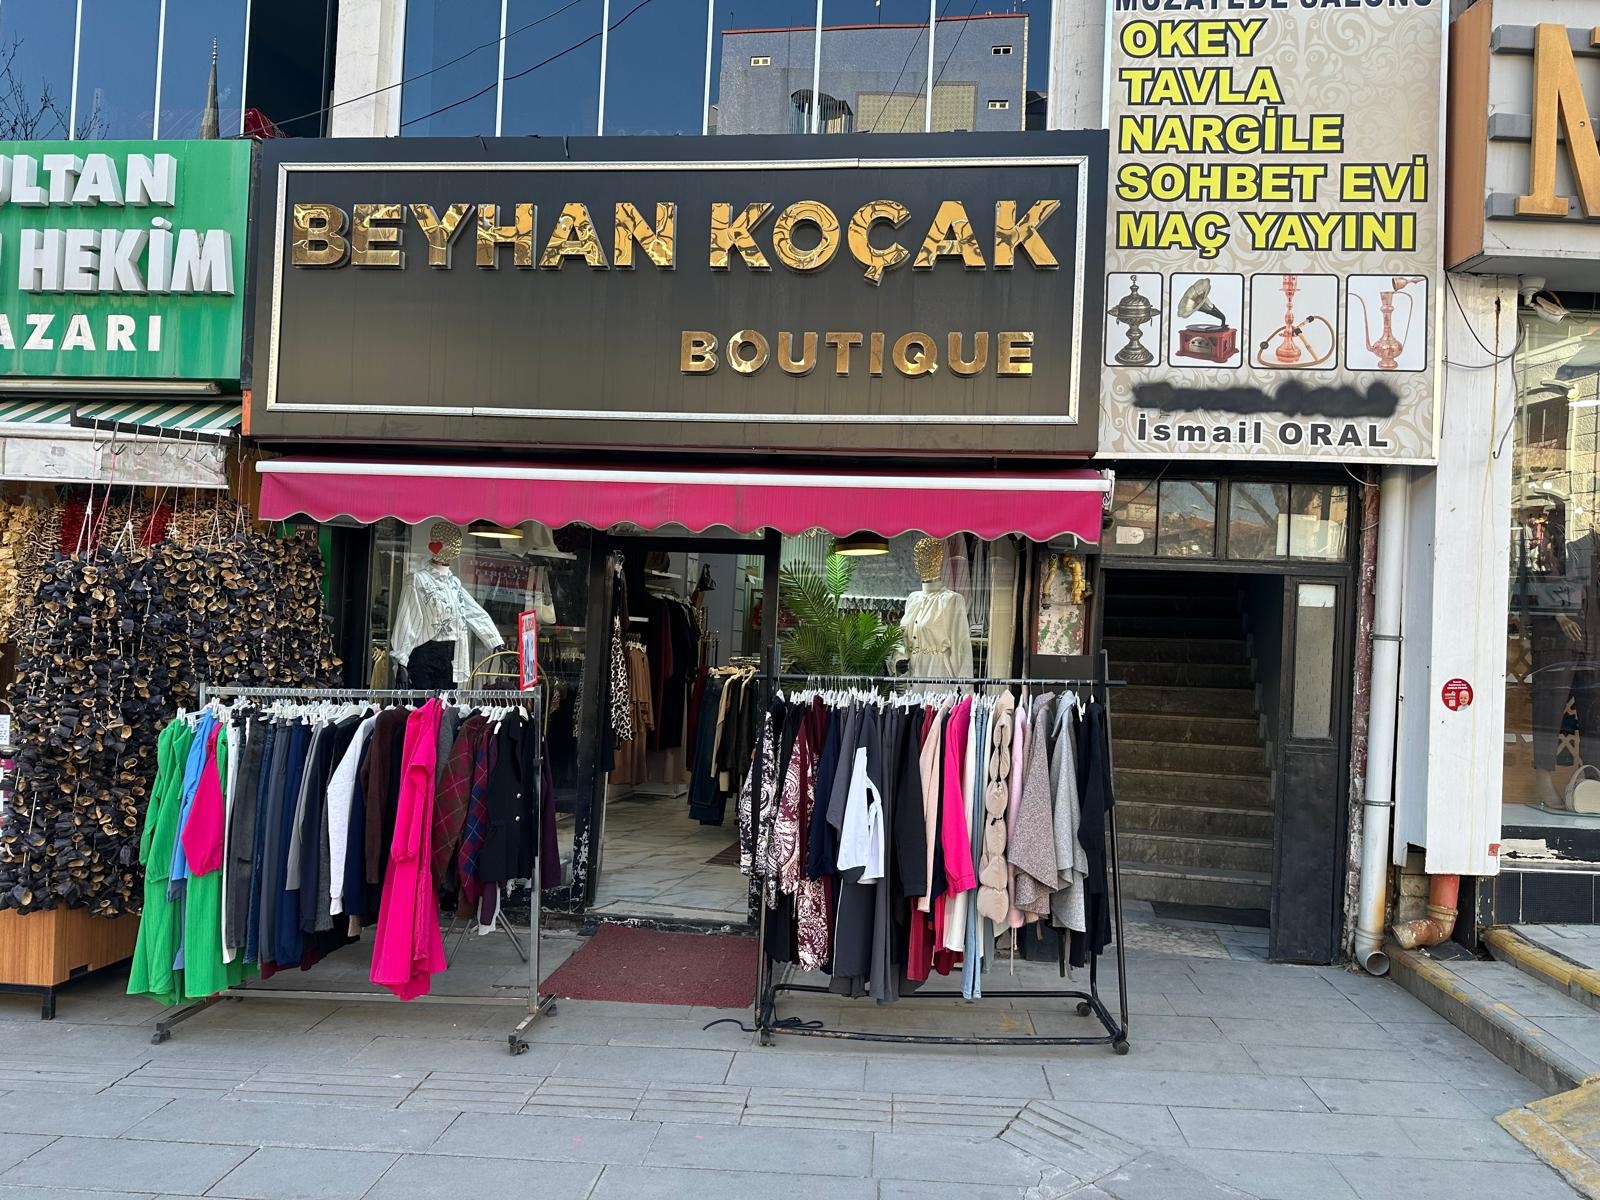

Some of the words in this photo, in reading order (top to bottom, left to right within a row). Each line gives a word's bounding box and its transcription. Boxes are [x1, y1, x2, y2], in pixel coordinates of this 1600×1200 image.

[1120, 18, 1268, 57] OKEY
[1119, 66, 1285, 105] TAVLA
[1119, 106, 1344, 153] NARGİLE
[1116, 163, 1328, 202] SOHBET
[1340, 154, 1428, 202] EVİ
[18, 216, 235, 295] HEKİM
[292, 201, 677, 271] BEYHAN
[709, 199, 1062, 286] KOÇAK
[1116, 211, 1230, 259] MAÇ
[1238, 212, 1417, 251] YAYINI
[680, 329, 1035, 377] BOUTIQUE
[1137, 413, 1262, 444] İsmail
[1278, 422, 1389, 447] ORAL
